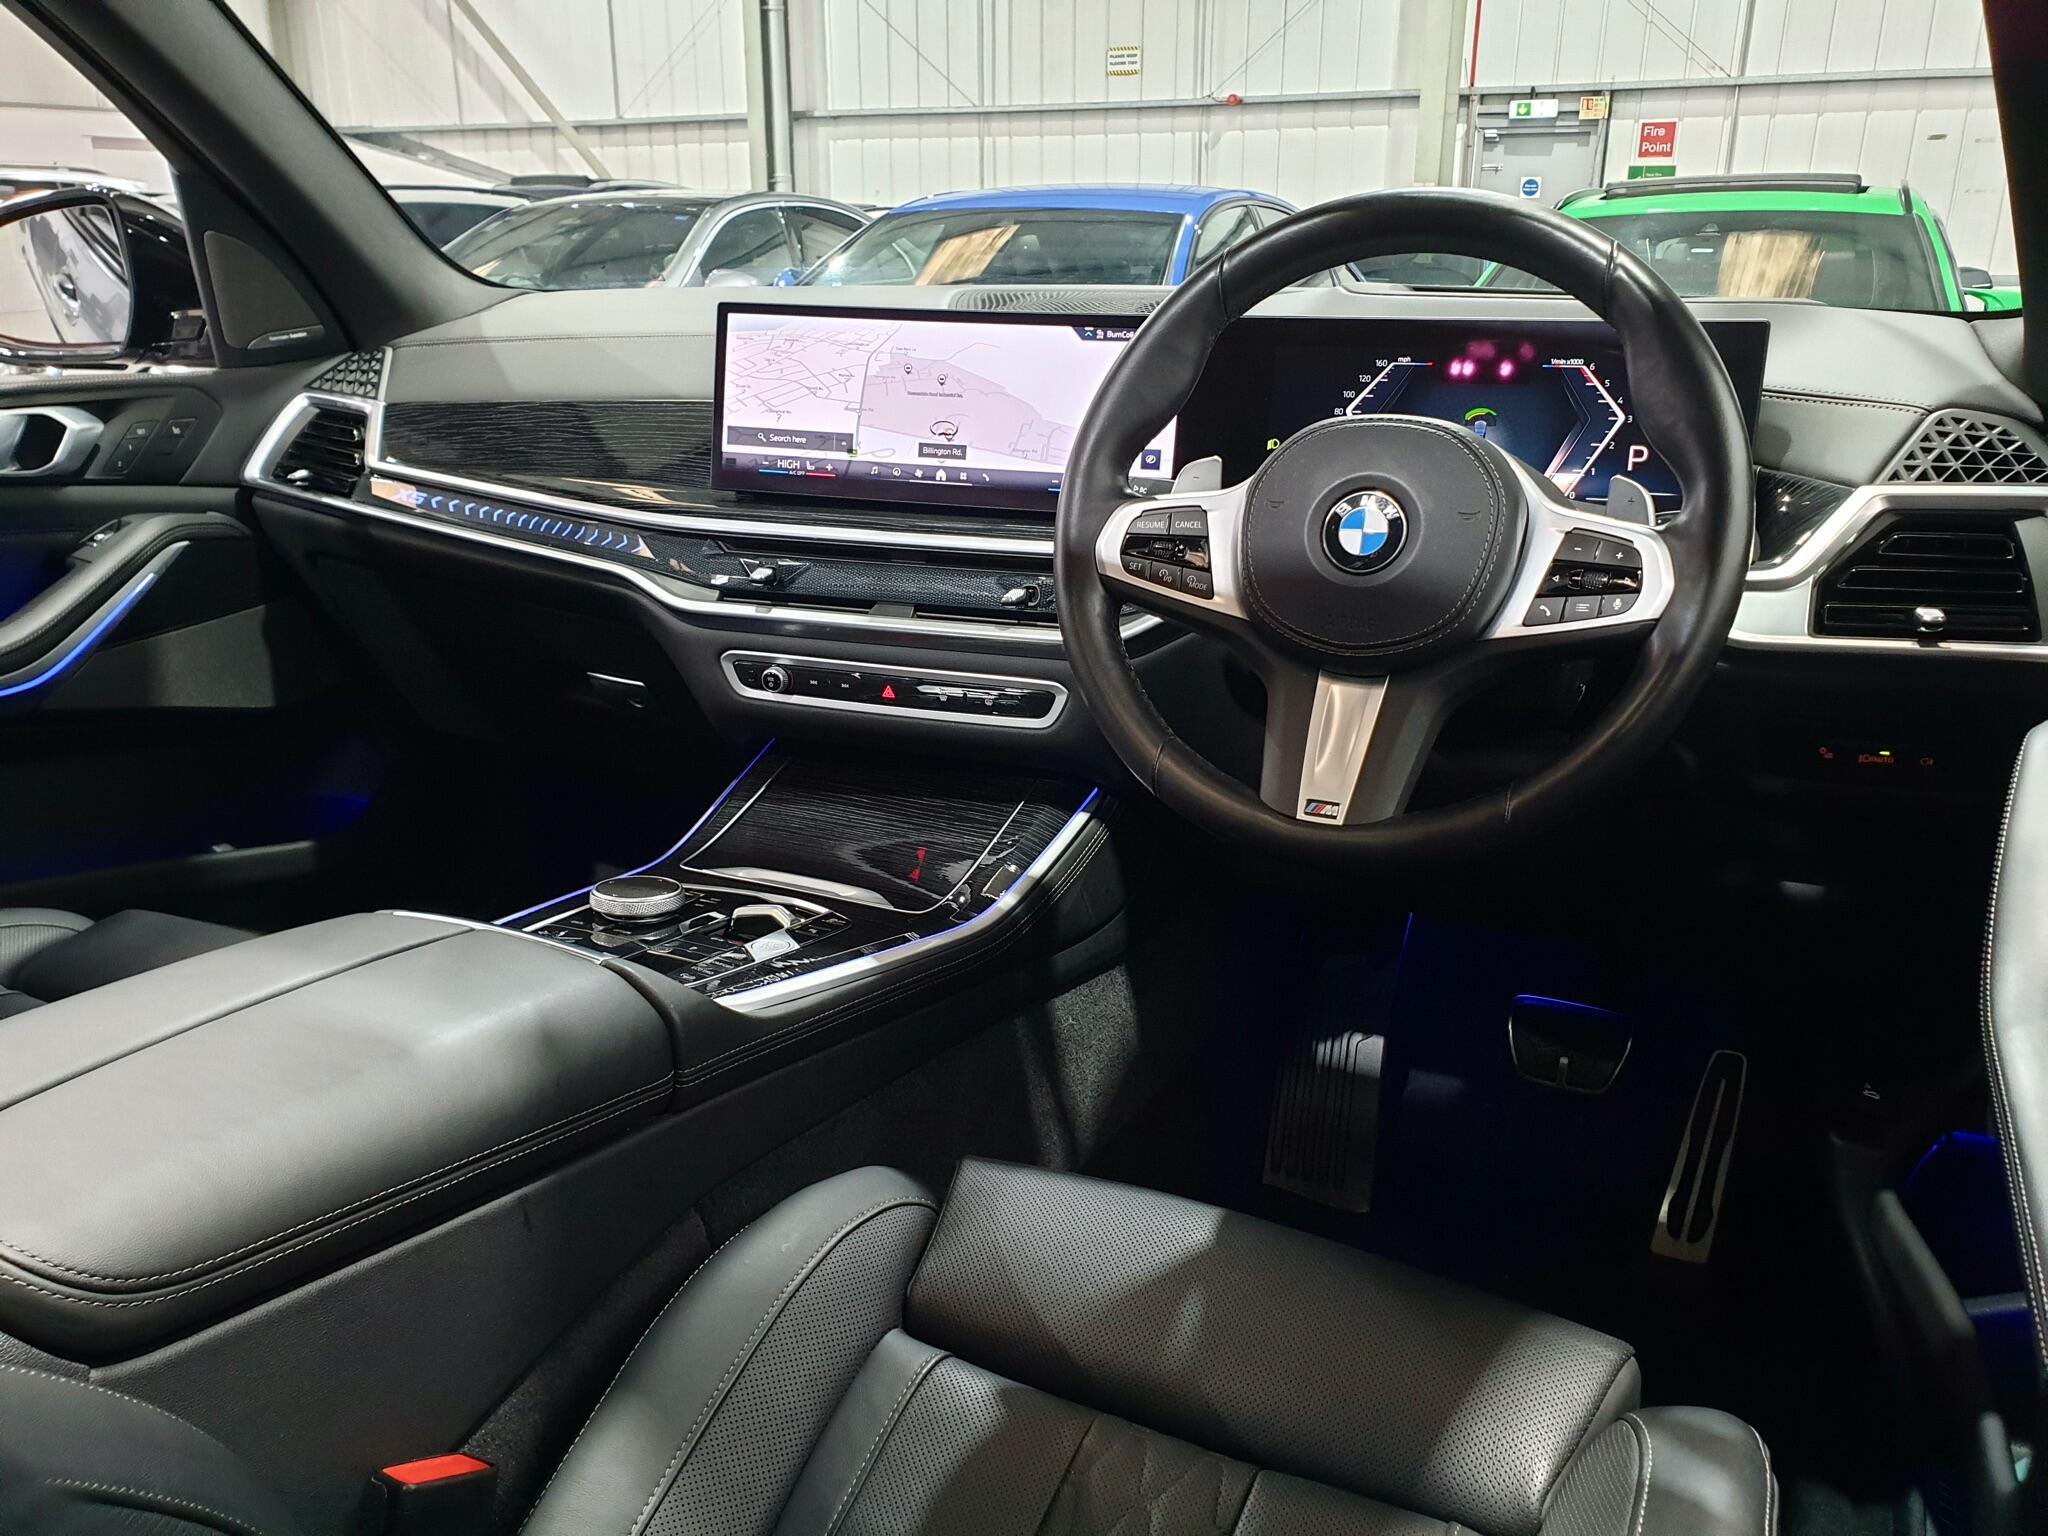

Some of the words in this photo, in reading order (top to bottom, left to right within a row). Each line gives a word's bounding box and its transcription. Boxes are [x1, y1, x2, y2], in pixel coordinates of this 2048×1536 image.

[1643, 126, 1666, 137] Fire
[1641, 141, 1672, 153] Point
[1375, 359, 1388, 367] 160
[1617, 396, 1623, 404] 4
[1627, 415, 1633, 423] 3
[769, 433, 792, 443] Search
[792, 435, 807, 444] here
[922, 446, 951, 457] Billington
[1627, 445, 1649, 471] P
[777, 459, 800, 469] HIGH
[1569, 491, 1576, 499] 0
[1335, 495, 1400, 521] BMW
[1136, 521, 1165, 529] RESUME
[1175, 521, 1202, 529] CANCEL
[1129, 562, 1142, 571] SET
[1188, 581, 1208, 591] MODE
